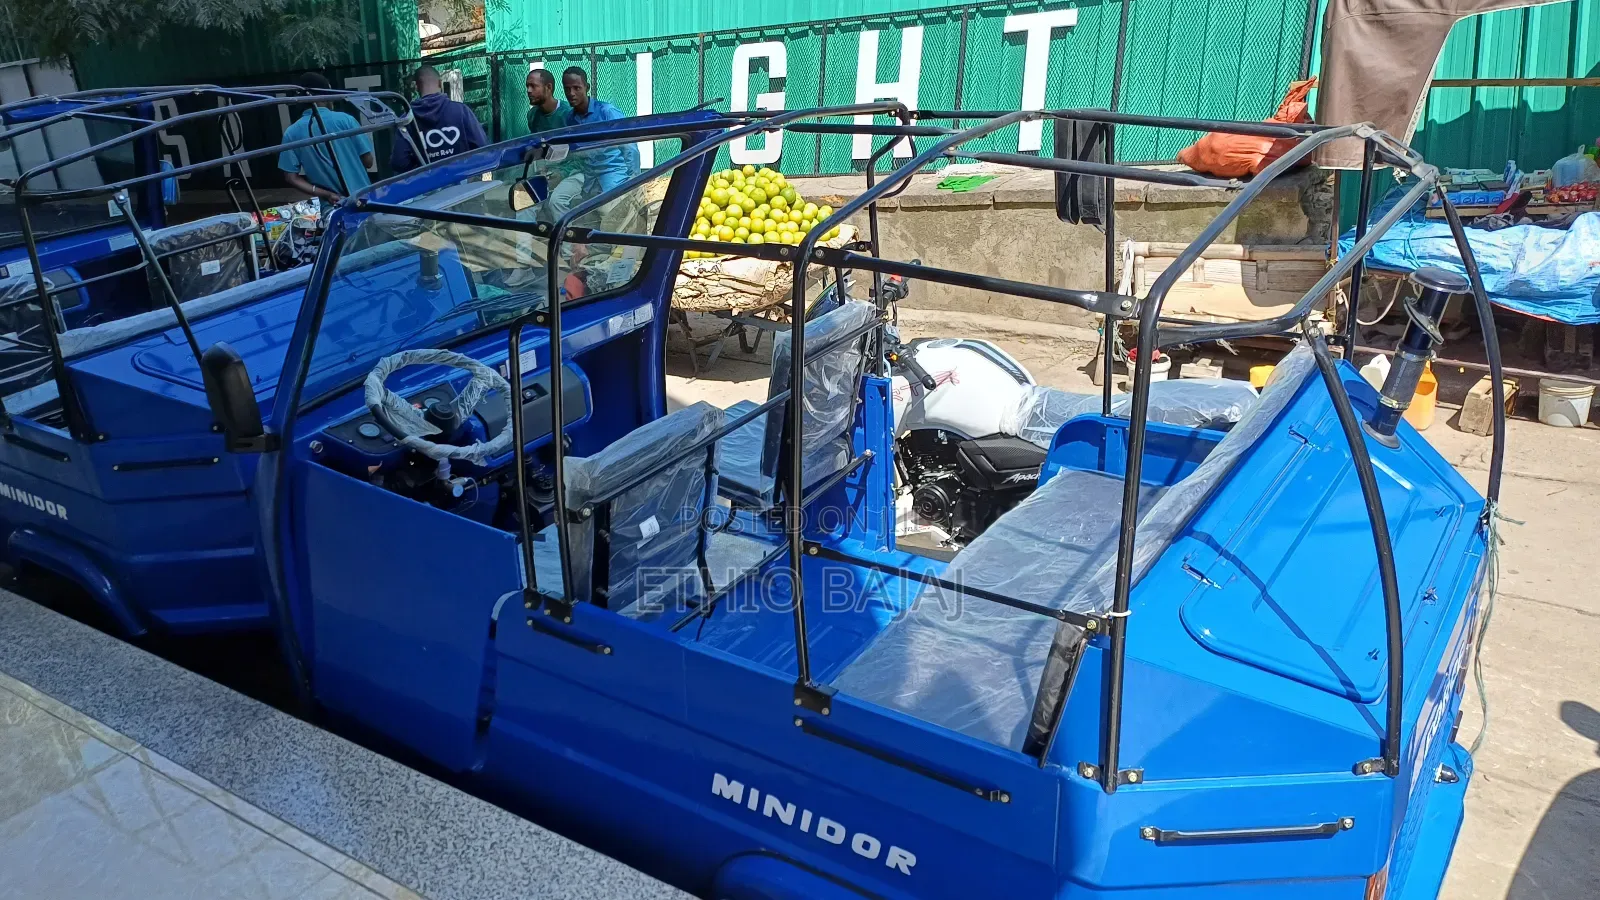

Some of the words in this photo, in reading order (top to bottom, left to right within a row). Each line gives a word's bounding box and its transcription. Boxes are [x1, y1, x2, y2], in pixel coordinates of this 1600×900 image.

[529, 9, 1077, 170] IGHT
[0, 482, 68, 520] MINIDOR
[1001, 472, 1040, 484] Apac
[711, 772, 917, 876] MINIDOR
